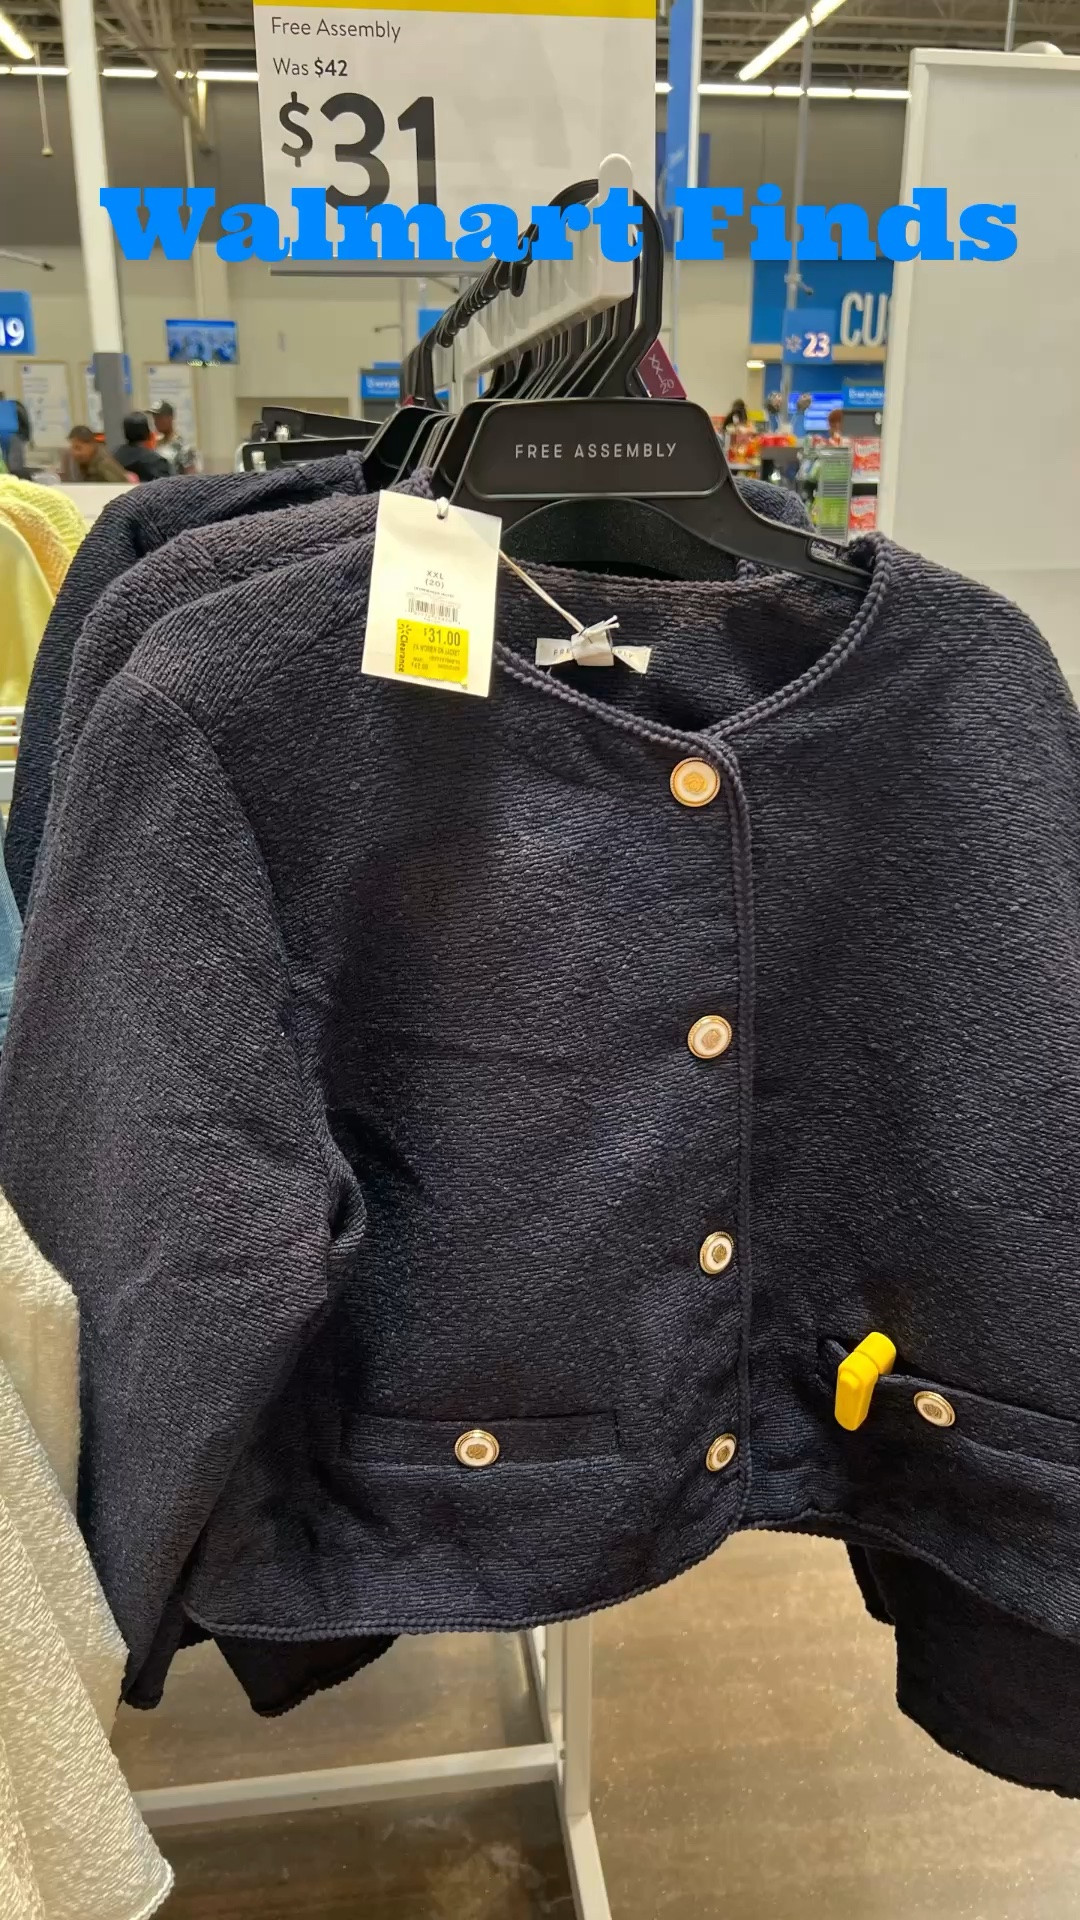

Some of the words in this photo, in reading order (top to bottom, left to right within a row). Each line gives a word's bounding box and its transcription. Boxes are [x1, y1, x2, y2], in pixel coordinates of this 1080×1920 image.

[271, 17, 312, 35] Free
[316, 19, 401, 43] Assembly
[273, 58, 309, 75] Was
[314, 60, 348, 77] $42
[279, 91, 438, 214] $31
[840, 291, 889, 347] CU
[803, 332, 831, 358] 23
[515, 443, 563, 459] FREE
[573, 442, 677, 459] ASSEMBLY
[425, 578, 445, 589] (20)
[426, 570, 444, 580] XXL
[423, 627, 461, 647] $31.00
[398, 634, 409, 673] Clearance
